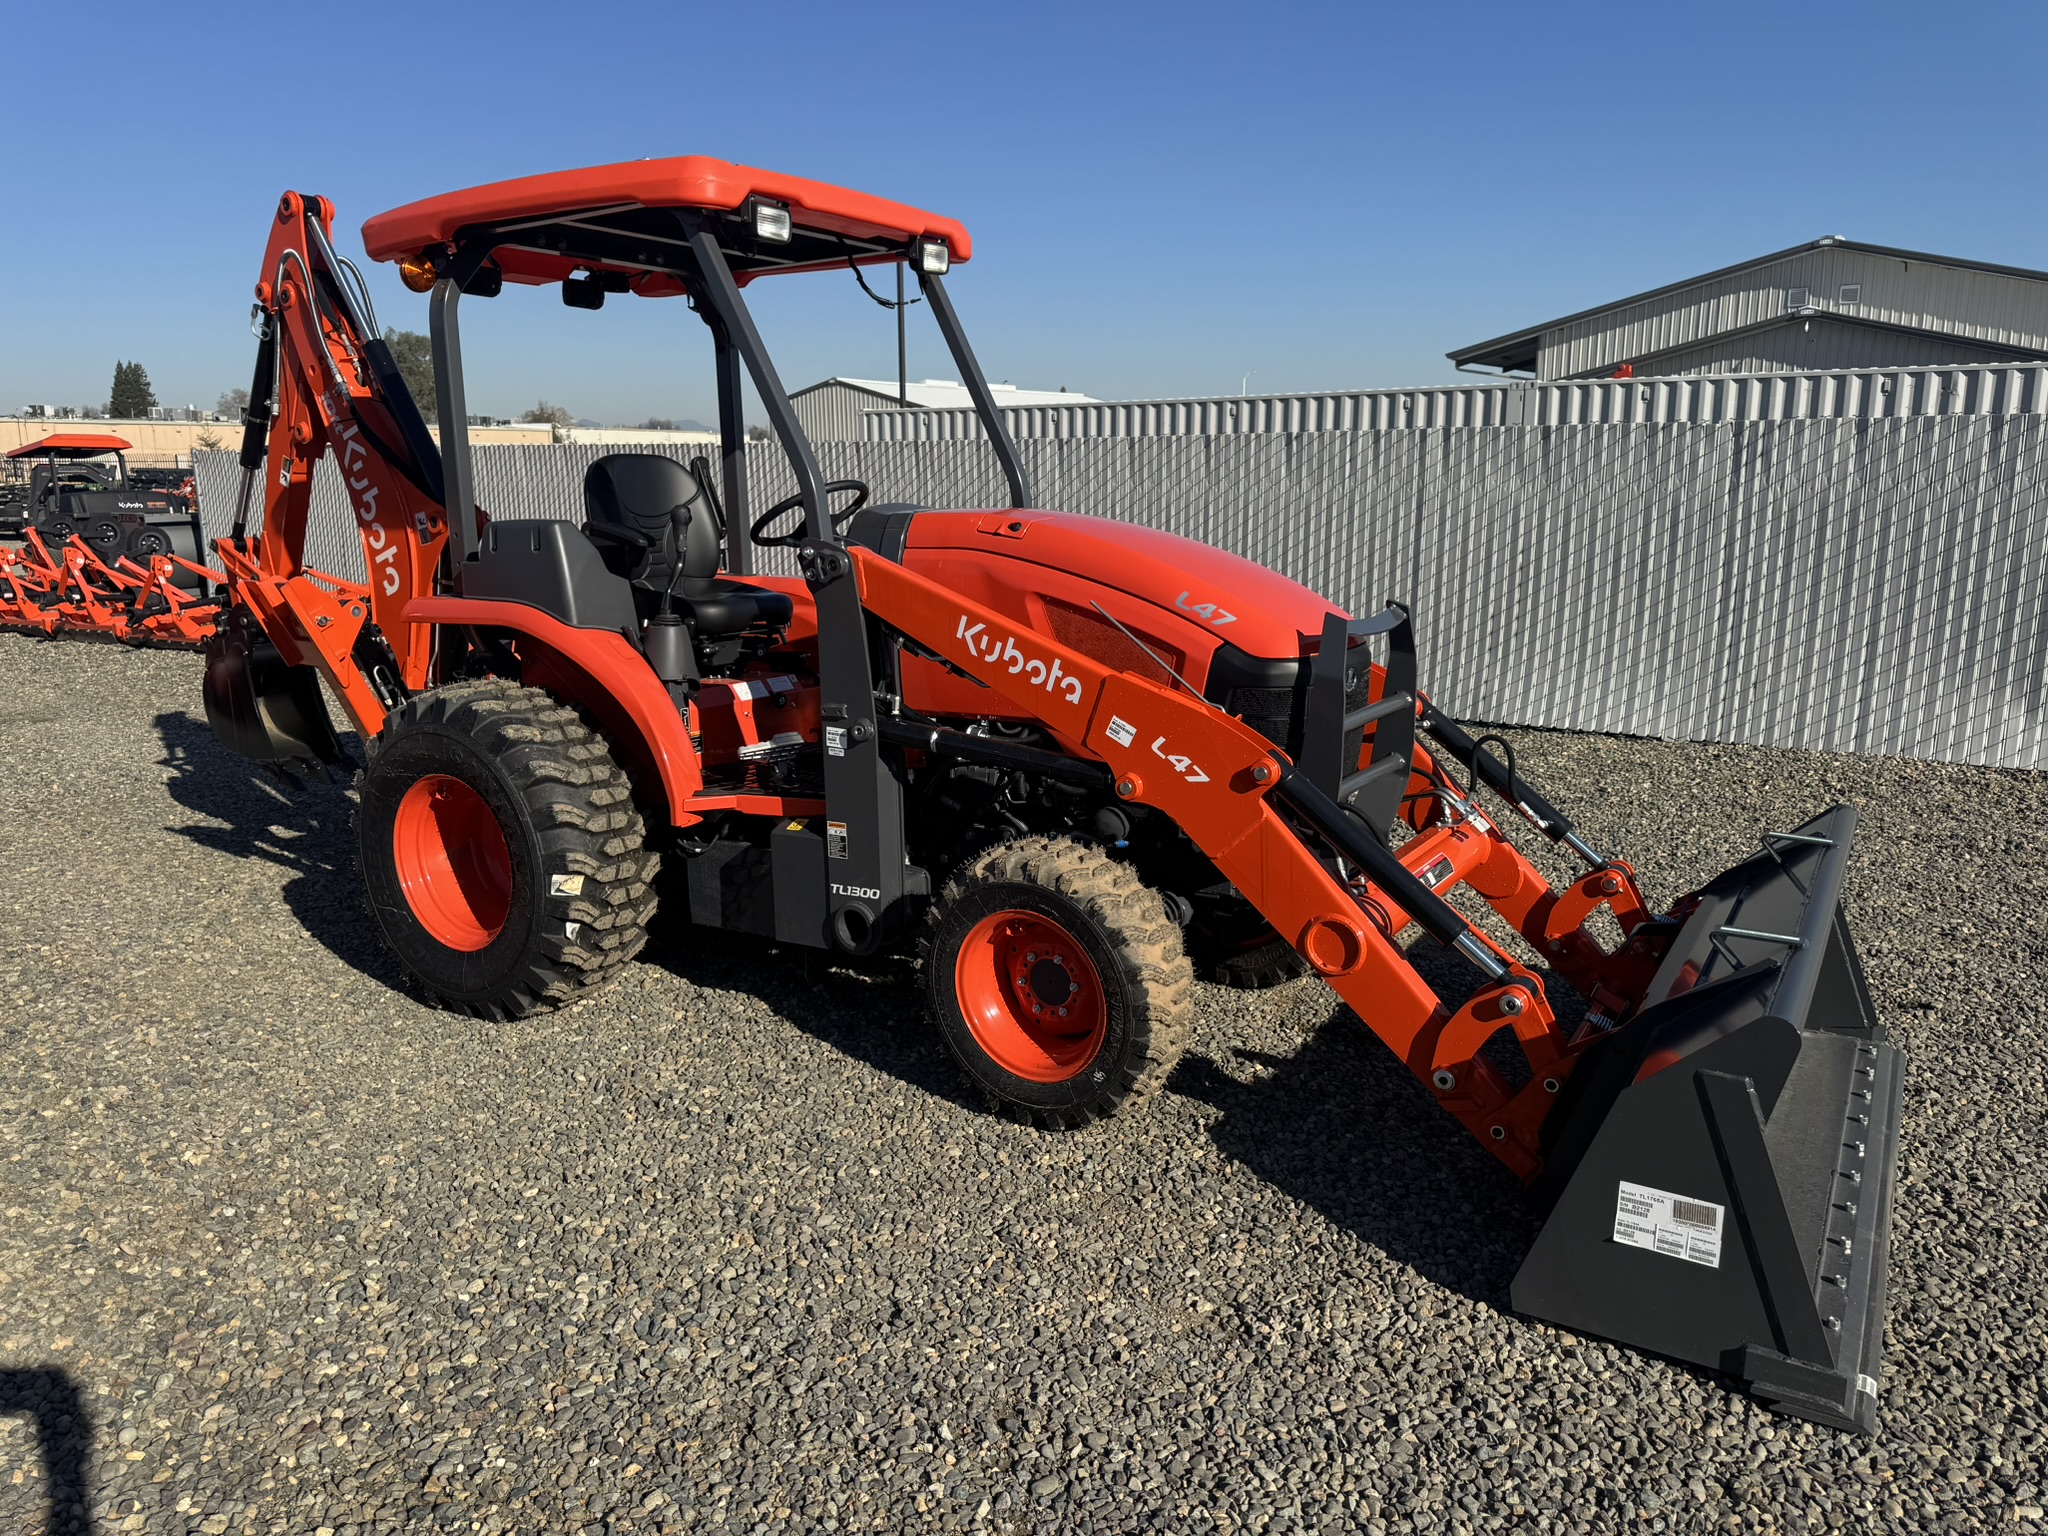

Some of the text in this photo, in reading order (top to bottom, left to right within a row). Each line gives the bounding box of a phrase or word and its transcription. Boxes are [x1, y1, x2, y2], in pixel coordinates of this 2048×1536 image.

[342, 424, 400, 597] Kubota
[1175, 591, 1238, 626] L47
[957, 615, 1082, 705] Kubota
[1151, 735, 1211, 783] L47
[830, 883, 880, 899] TL1300
